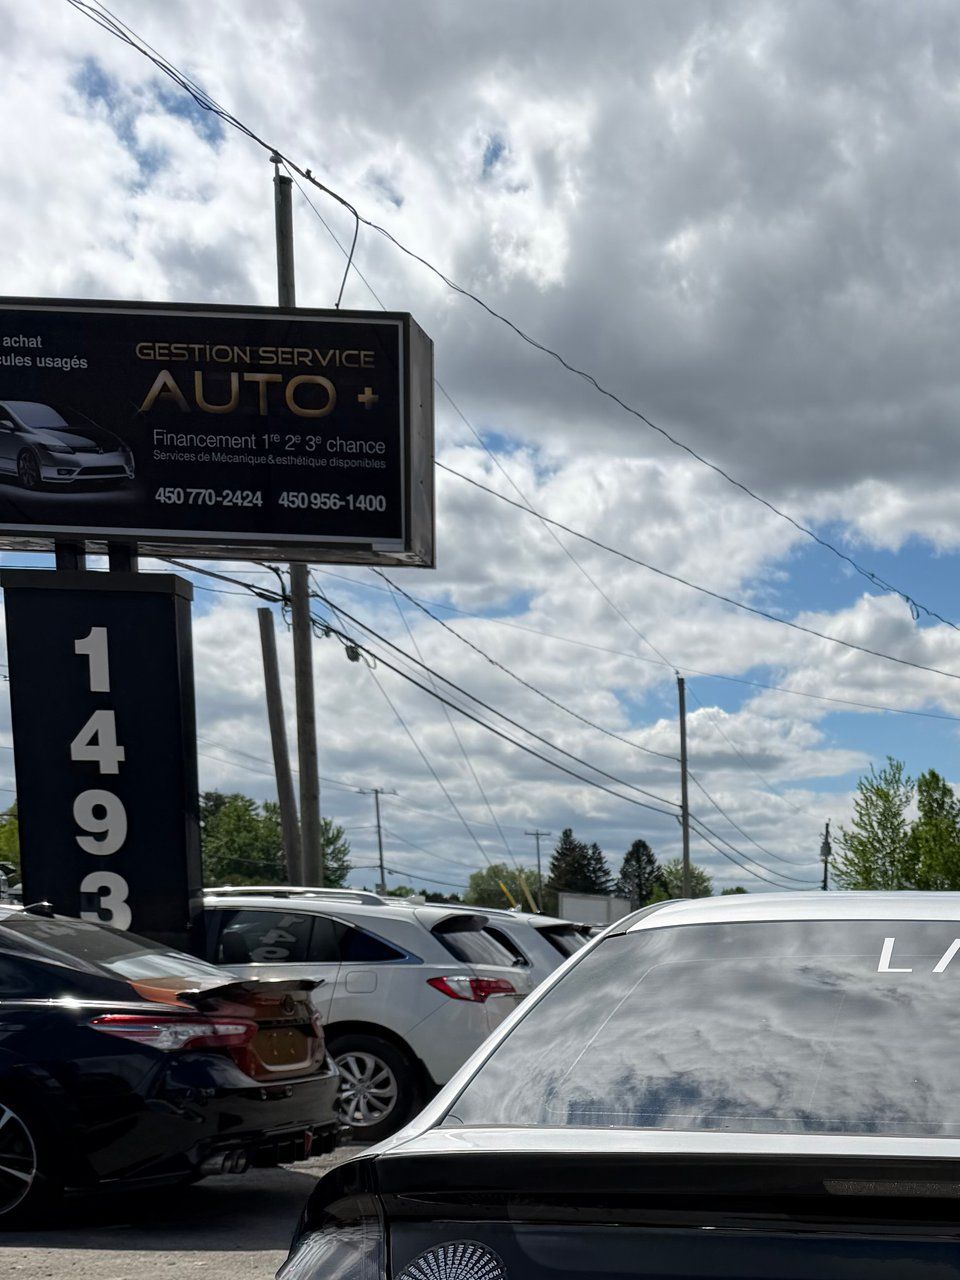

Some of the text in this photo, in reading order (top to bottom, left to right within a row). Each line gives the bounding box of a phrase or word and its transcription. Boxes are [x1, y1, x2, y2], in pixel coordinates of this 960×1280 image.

[2, 334, 43, 348] achat
[0, 353, 89, 371] ules usagés
[135, 341, 376, 369] GESTION SERVICE
[139, 369, 337, 418] AUTO
[153, 428, 257, 451] Financement
[326, 436, 387, 455] chance
[153, 449, 196, 463] Services
[197, 452, 211, 463] de
[329, 458, 387, 470] disponibles
[155, 487, 263, 508] 450 770-2424
[278, 492, 387, 513] 450 956-1400
